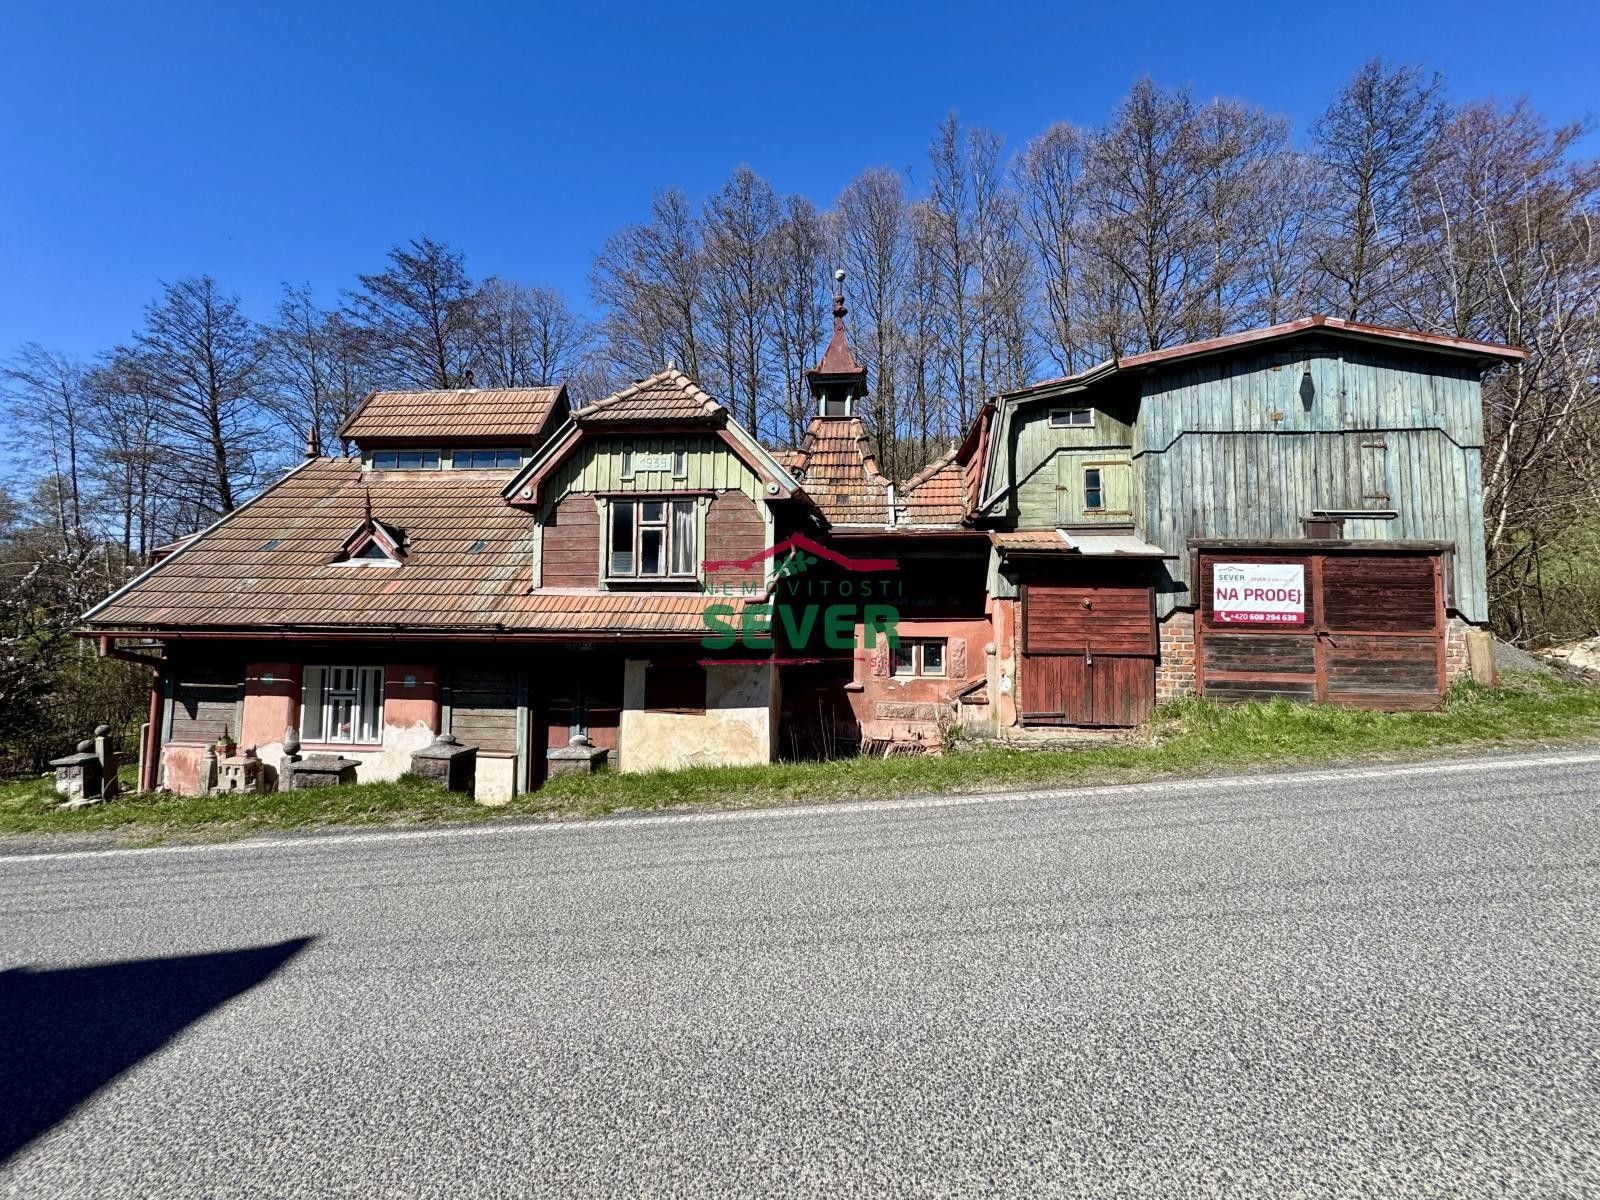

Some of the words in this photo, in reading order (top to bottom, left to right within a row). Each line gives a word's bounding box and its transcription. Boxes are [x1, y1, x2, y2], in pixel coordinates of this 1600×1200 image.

[640, 457, 667, 469] 1939
[1216, 587, 1239, 601] NA
[1243, 588, 1302, 605] PRODEJ
[1249, 613, 1264, 621] 608
